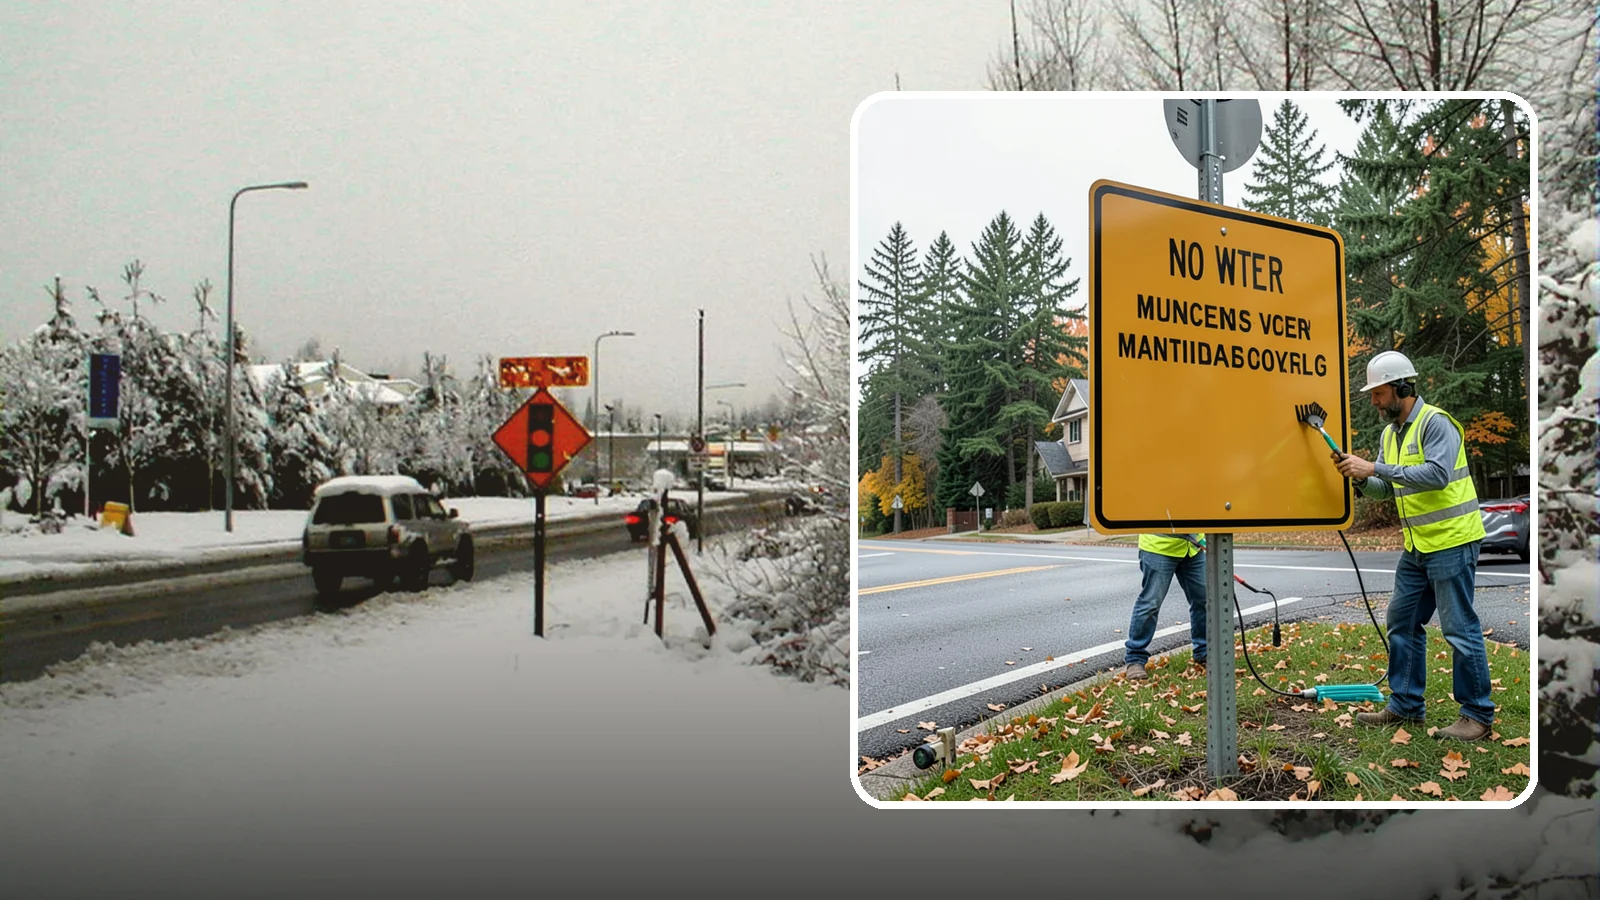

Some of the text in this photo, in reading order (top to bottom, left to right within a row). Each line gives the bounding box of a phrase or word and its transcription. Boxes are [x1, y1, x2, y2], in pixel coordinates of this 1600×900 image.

[1169, 237, 1284, 295] NO WTER
[1137, 294, 1252, 333] MUNCENS
